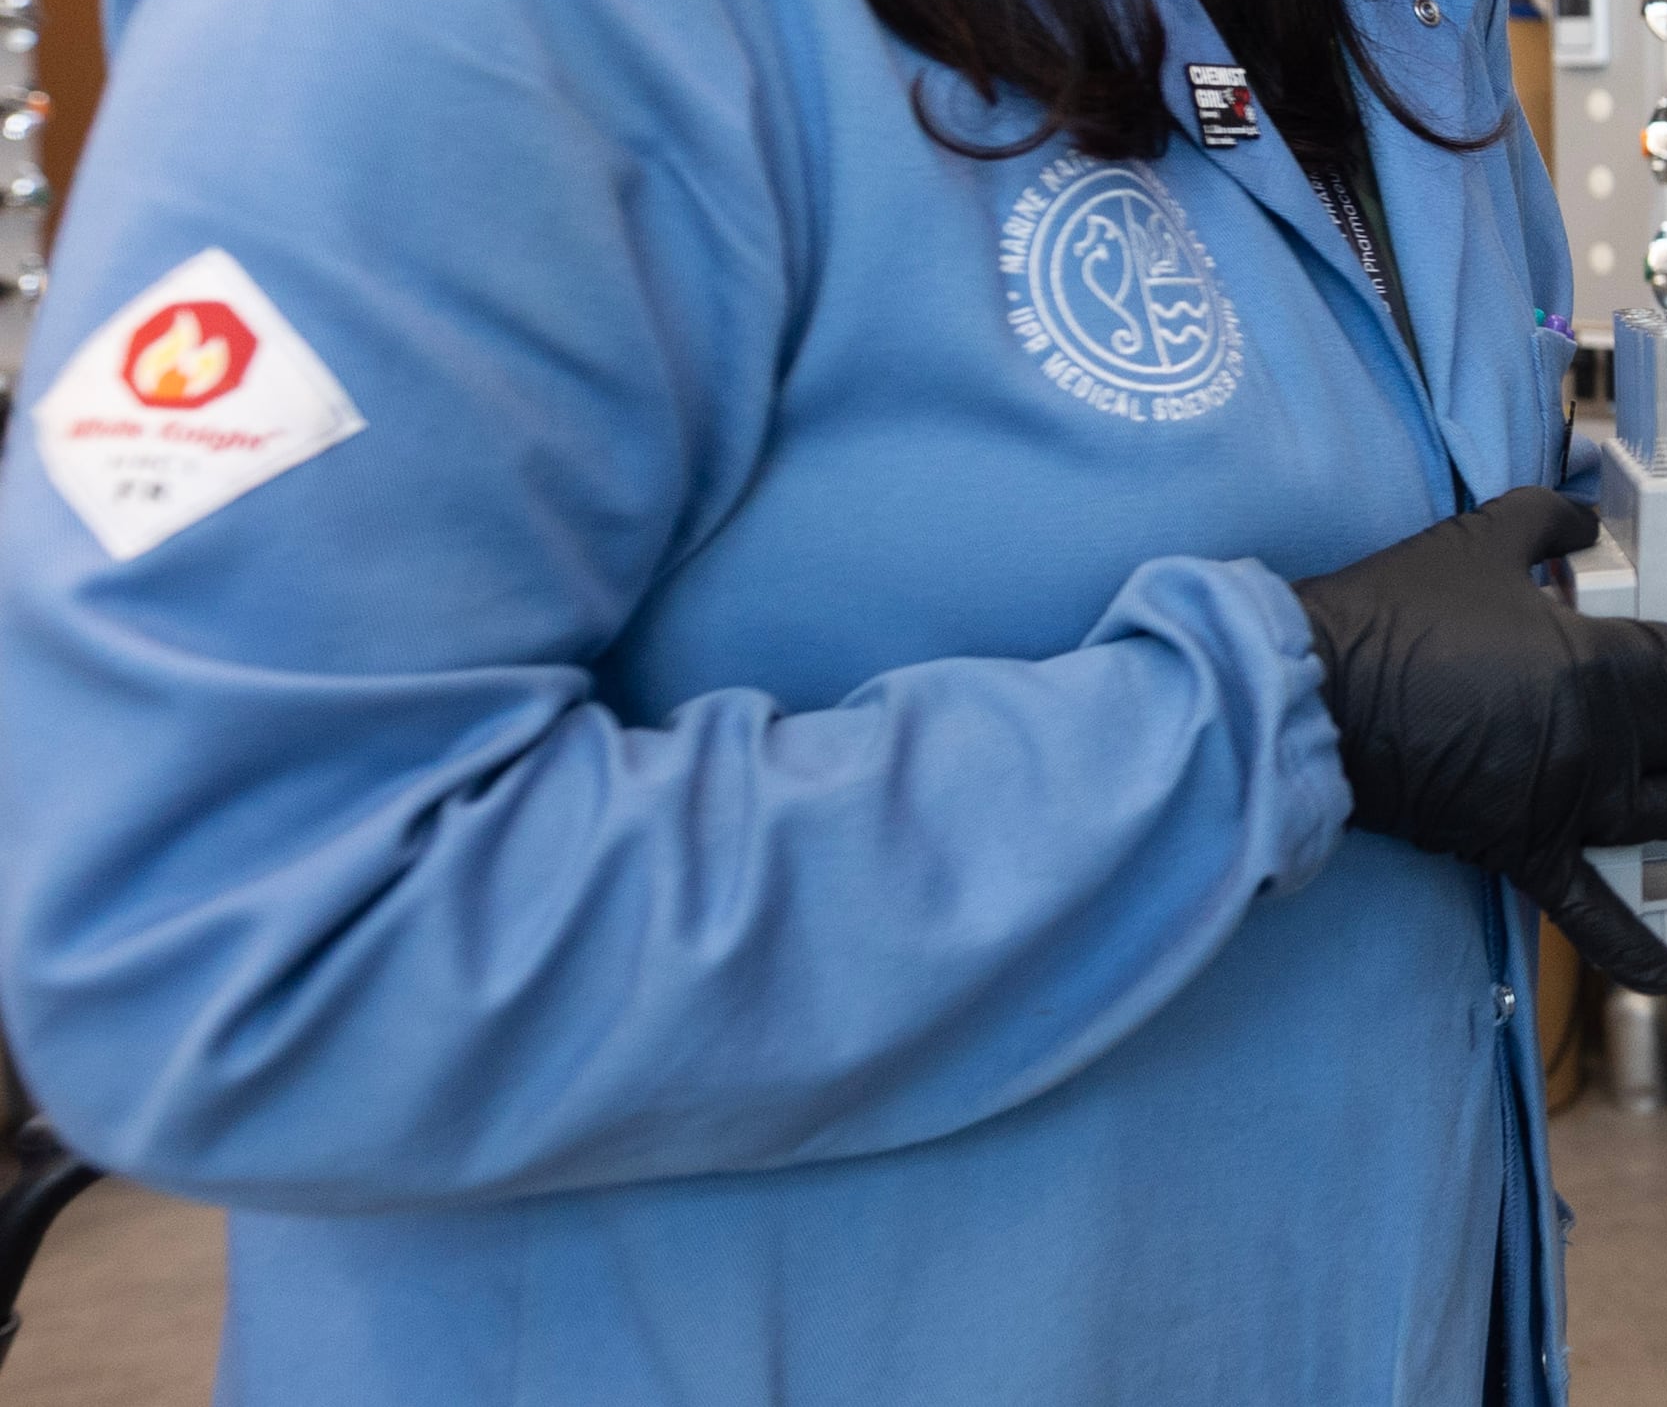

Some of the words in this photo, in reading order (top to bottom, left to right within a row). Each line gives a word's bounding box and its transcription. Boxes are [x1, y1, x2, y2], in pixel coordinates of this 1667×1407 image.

[998, 186, 1051, 275] MARINE
[1006, 305, 1051, 355] UPR
[1040, 352, 1147, 423] MEDICAL
[1151, 369, 1239, 423] SCIENCES
